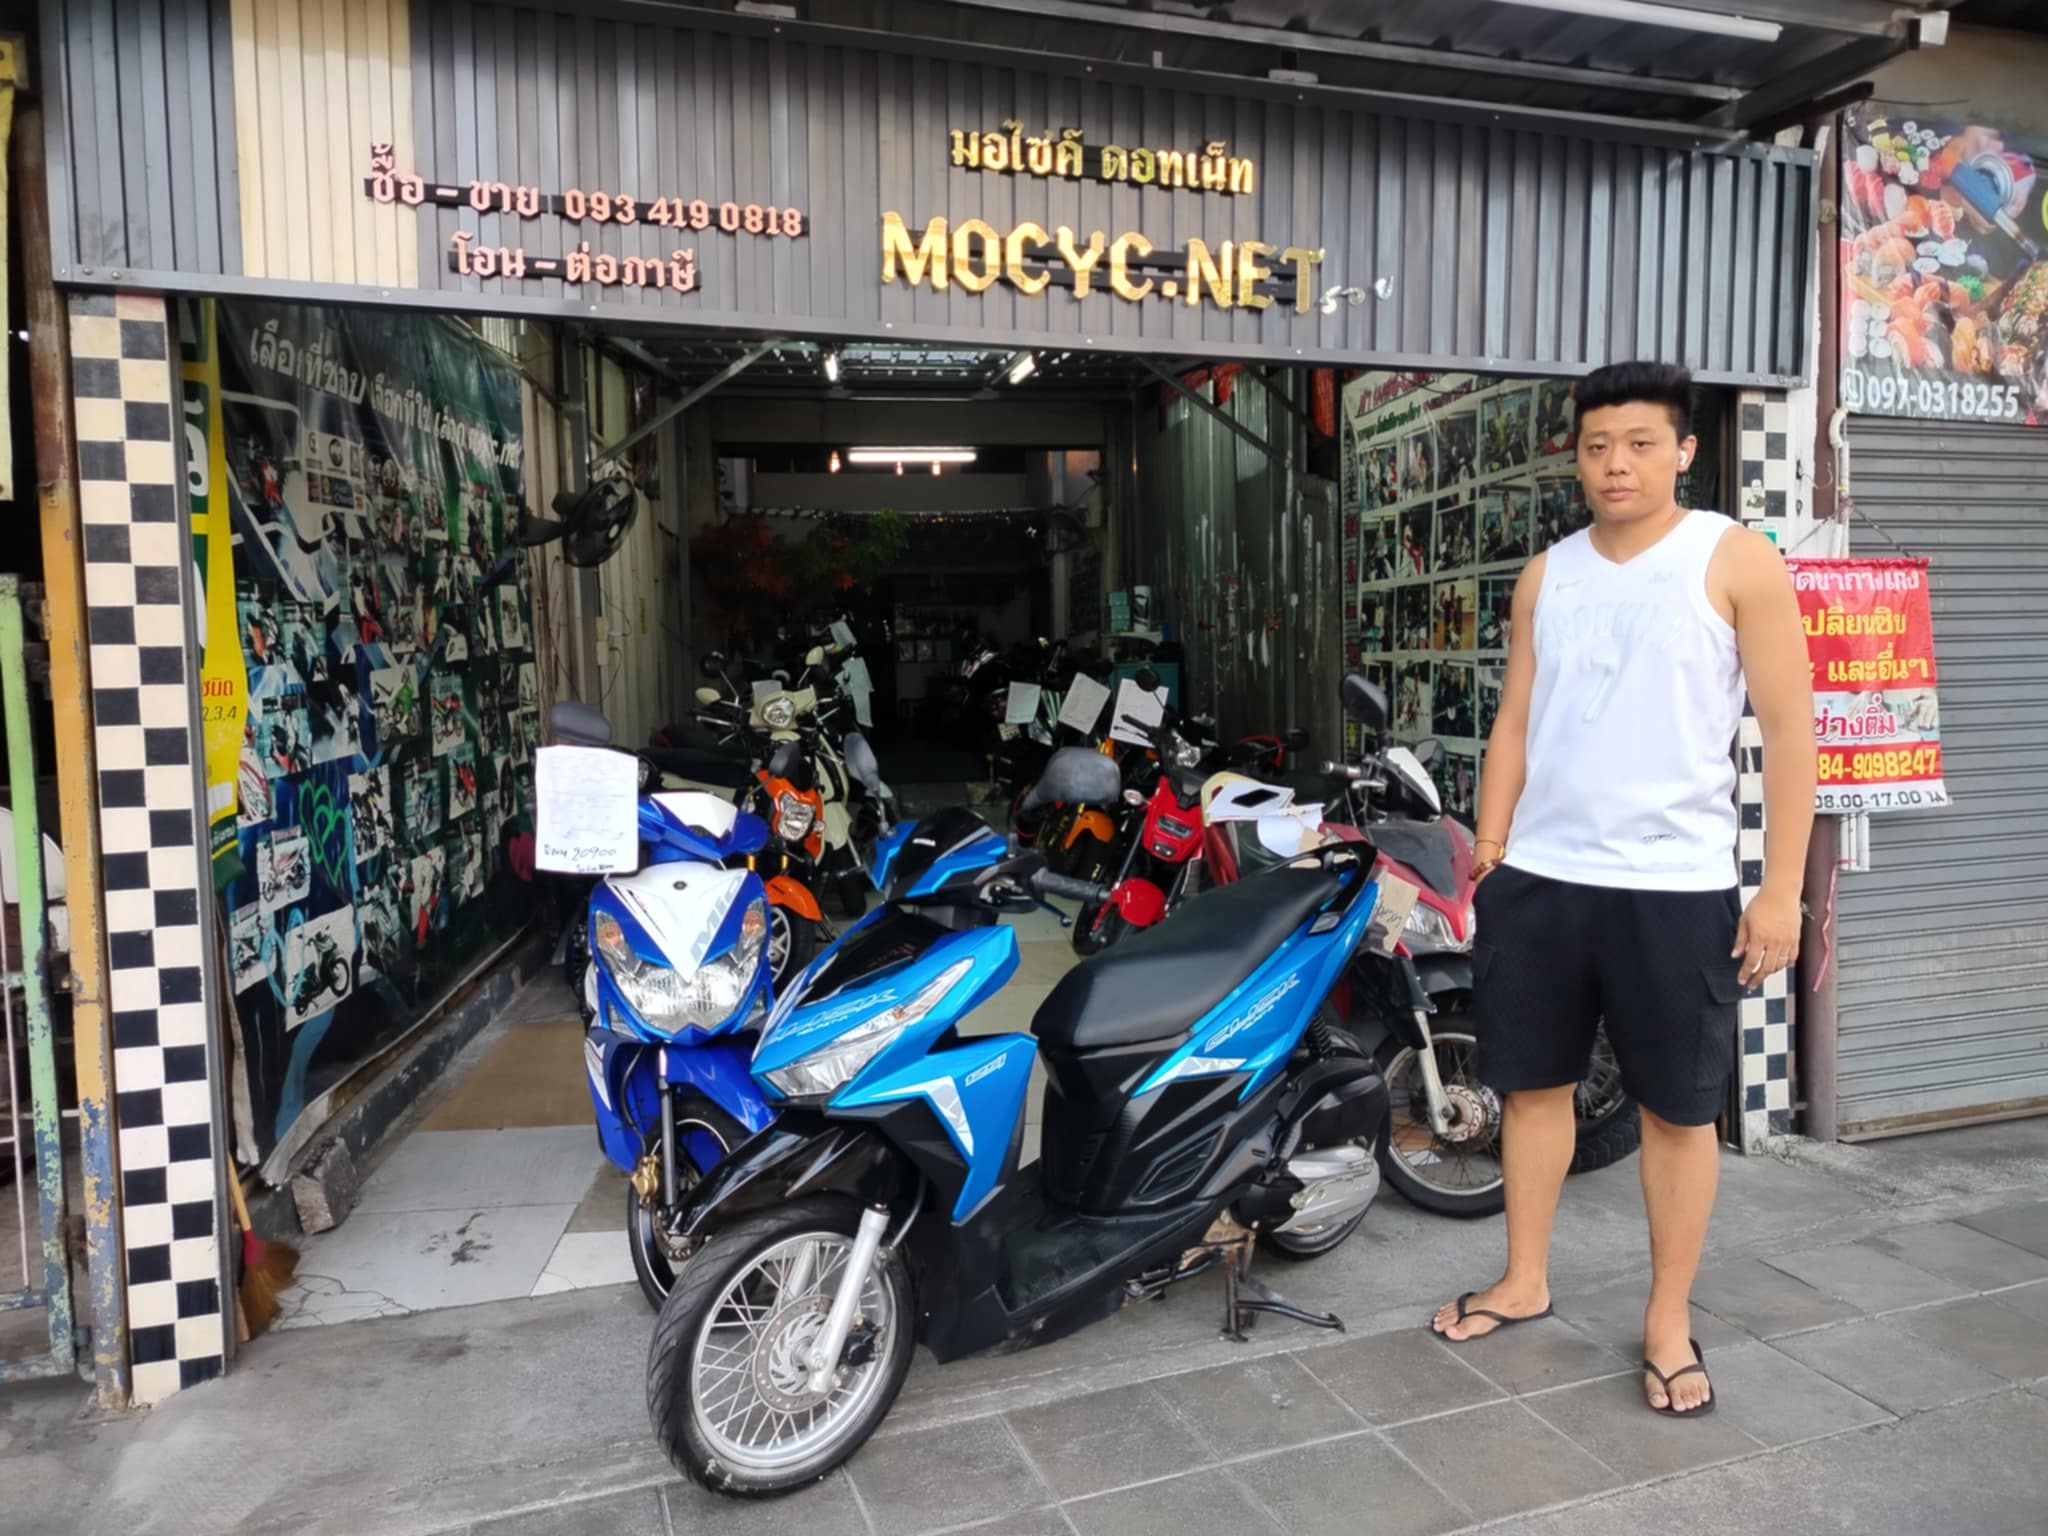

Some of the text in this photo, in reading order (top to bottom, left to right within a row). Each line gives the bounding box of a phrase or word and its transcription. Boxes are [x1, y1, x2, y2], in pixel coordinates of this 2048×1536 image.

[470, 180, 540, 217] ขาย
[565, 188, 636, 224] 093
[648, 196, 709, 230] 419
[720, 202, 802, 237] 0818
[451, 230, 526, 277] โอน
[566, 241, 695, 291] ต่อภาษี
[881, 210, 1325, 314] MOCYC.NET
[1867, 376, 2020, 417] 097-0318255
[1787, 563, 1919, 591] ัดขากางเกง
[1828, 641, 1928, 682] และอื่นๆ
